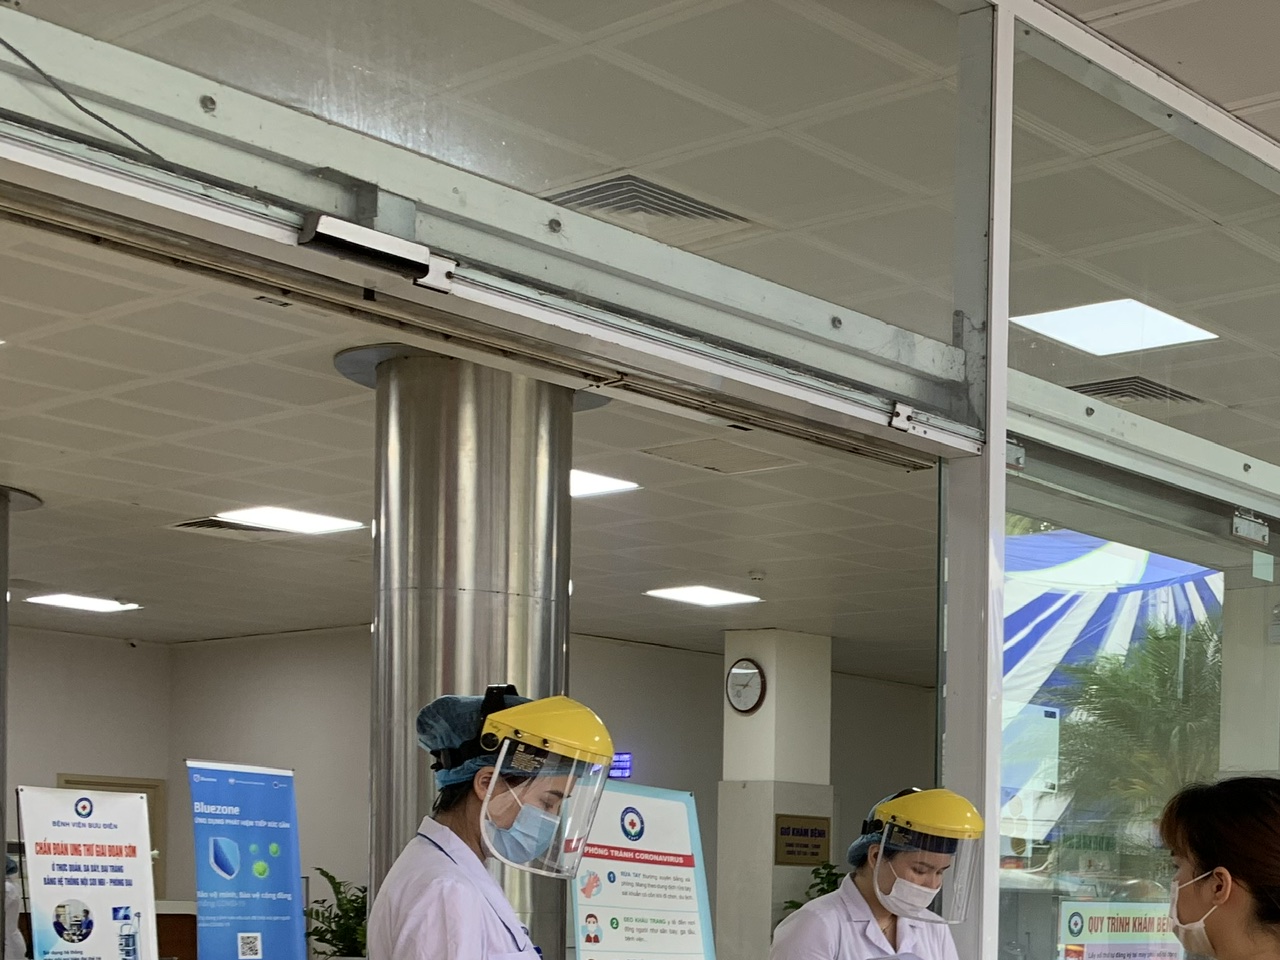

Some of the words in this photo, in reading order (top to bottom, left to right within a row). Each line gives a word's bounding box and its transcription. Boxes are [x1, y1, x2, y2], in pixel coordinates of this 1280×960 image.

[194, 802, 240, 814] Bluezone
[584, 846, 608, 856] PHÒNG
[610, 848, 634, 859] TRÁNH
[635, 852, 684, 864] CORONAVIRUS
[1088, 916, 1104, 934] QUY
[1107, 913, 1130, 933] TRÌNH
[1132, 914, 1155, 932] KHÁM
[1157, 913, 1173, 936] BỆN
